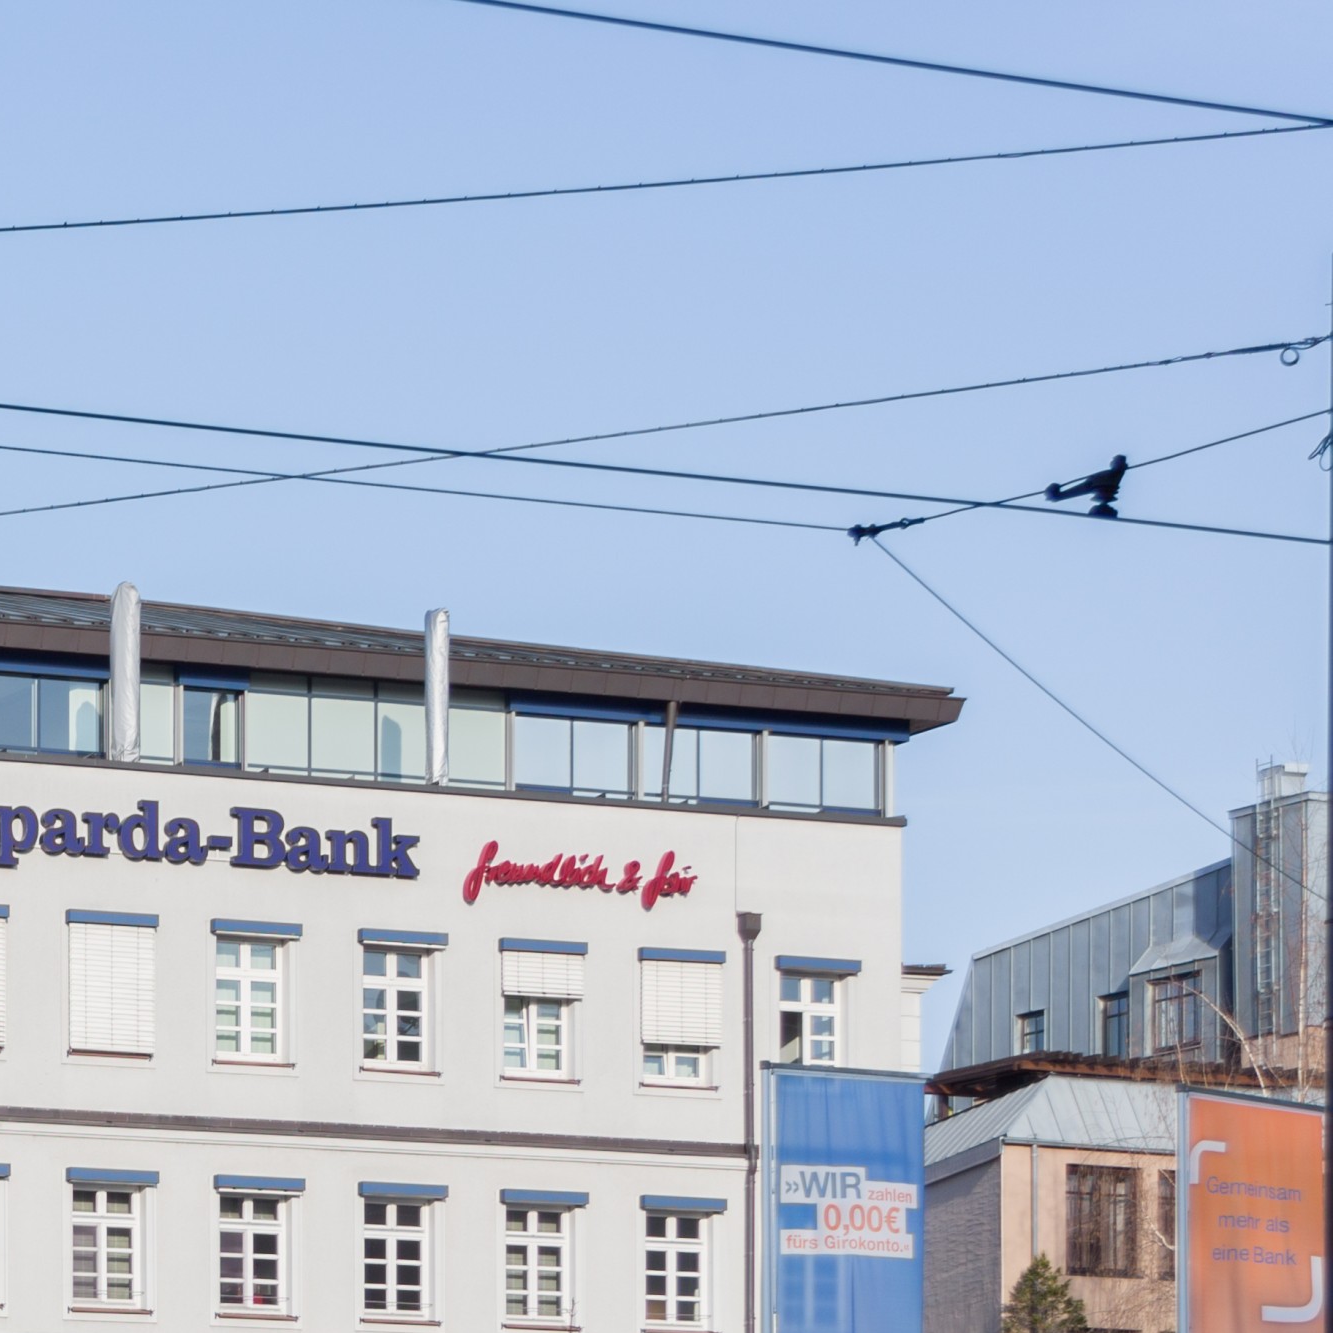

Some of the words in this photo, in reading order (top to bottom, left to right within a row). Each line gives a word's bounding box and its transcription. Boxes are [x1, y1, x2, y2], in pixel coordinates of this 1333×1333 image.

[462, 840, 616, 905] freundlich
[616, 860, 642, 894] &
[641, 850, 698, 912] fair
[867, 1188, 913, 1204] zahlen
[1206, 1176, 1302, 1201] Gemeinsam
[823, 1204, 901, 1236] 0,00€
[1217, 1213, 1261, 1229] mehr
[1265, 1218, 1290, 1233] als
[785, 1235, 818, 1249] fürs
[1212, 1246, 1249, 1261] eine
[1252, 1246, 1297, 1265] Bank
